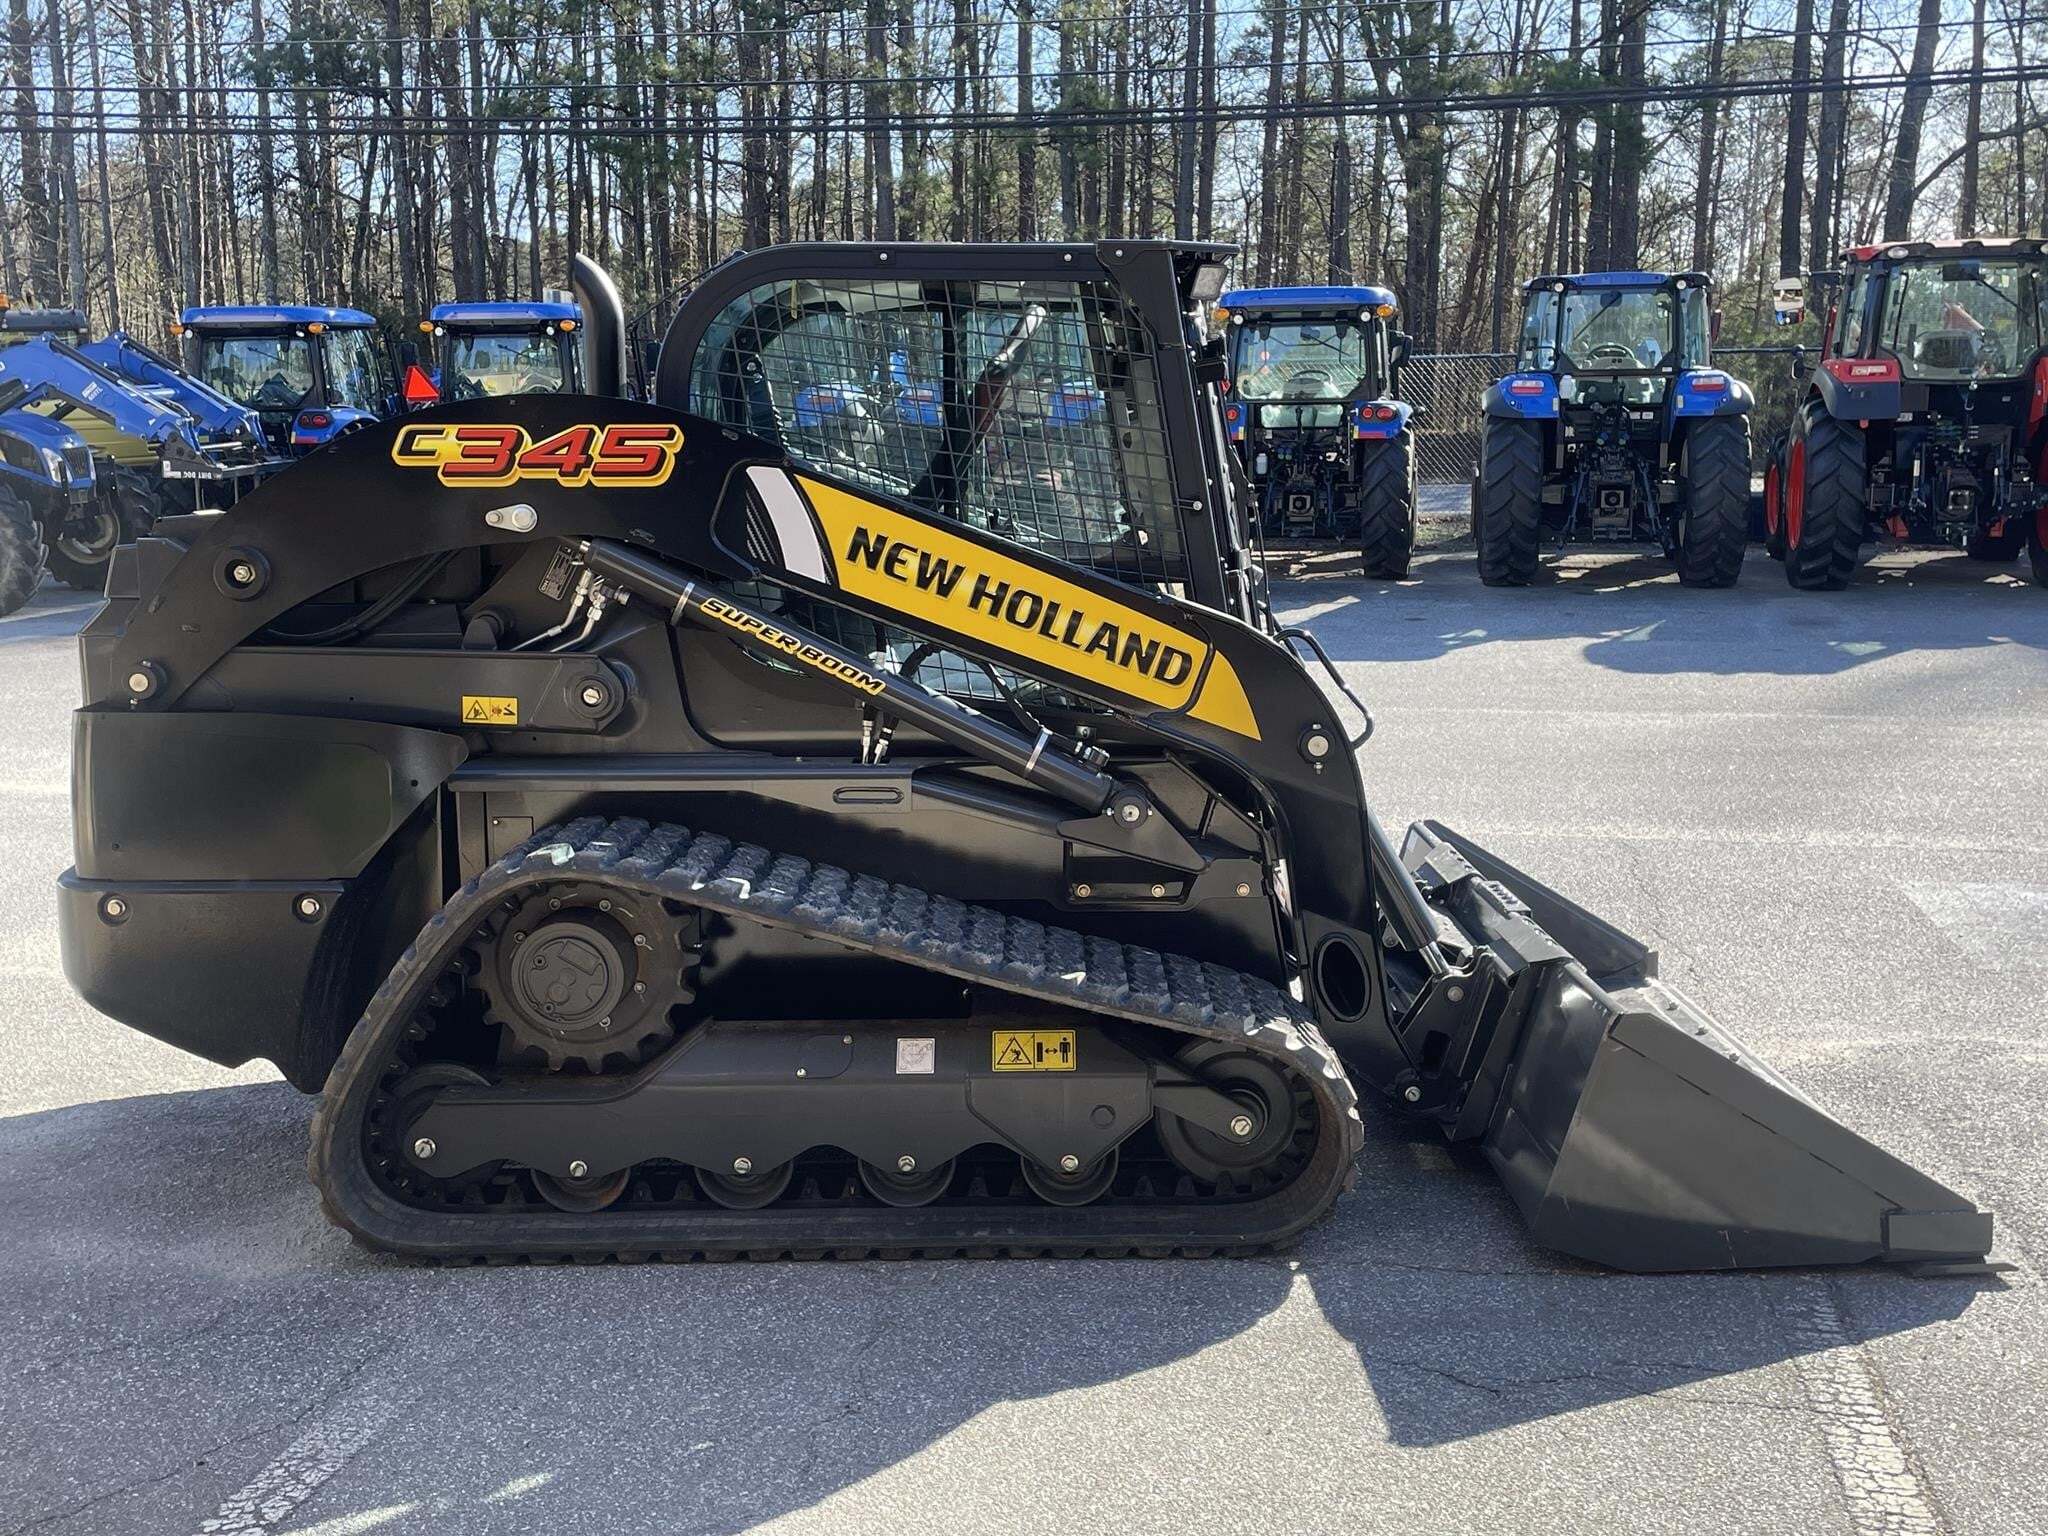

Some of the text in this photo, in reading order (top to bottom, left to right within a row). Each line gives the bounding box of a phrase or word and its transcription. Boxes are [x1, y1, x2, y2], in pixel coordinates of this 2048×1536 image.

[392, 424, 684, 487] C345
[701, 597, 887, 696] SUPER BOOM
[845, 525, 1195, 688] NEW HOLLAND
